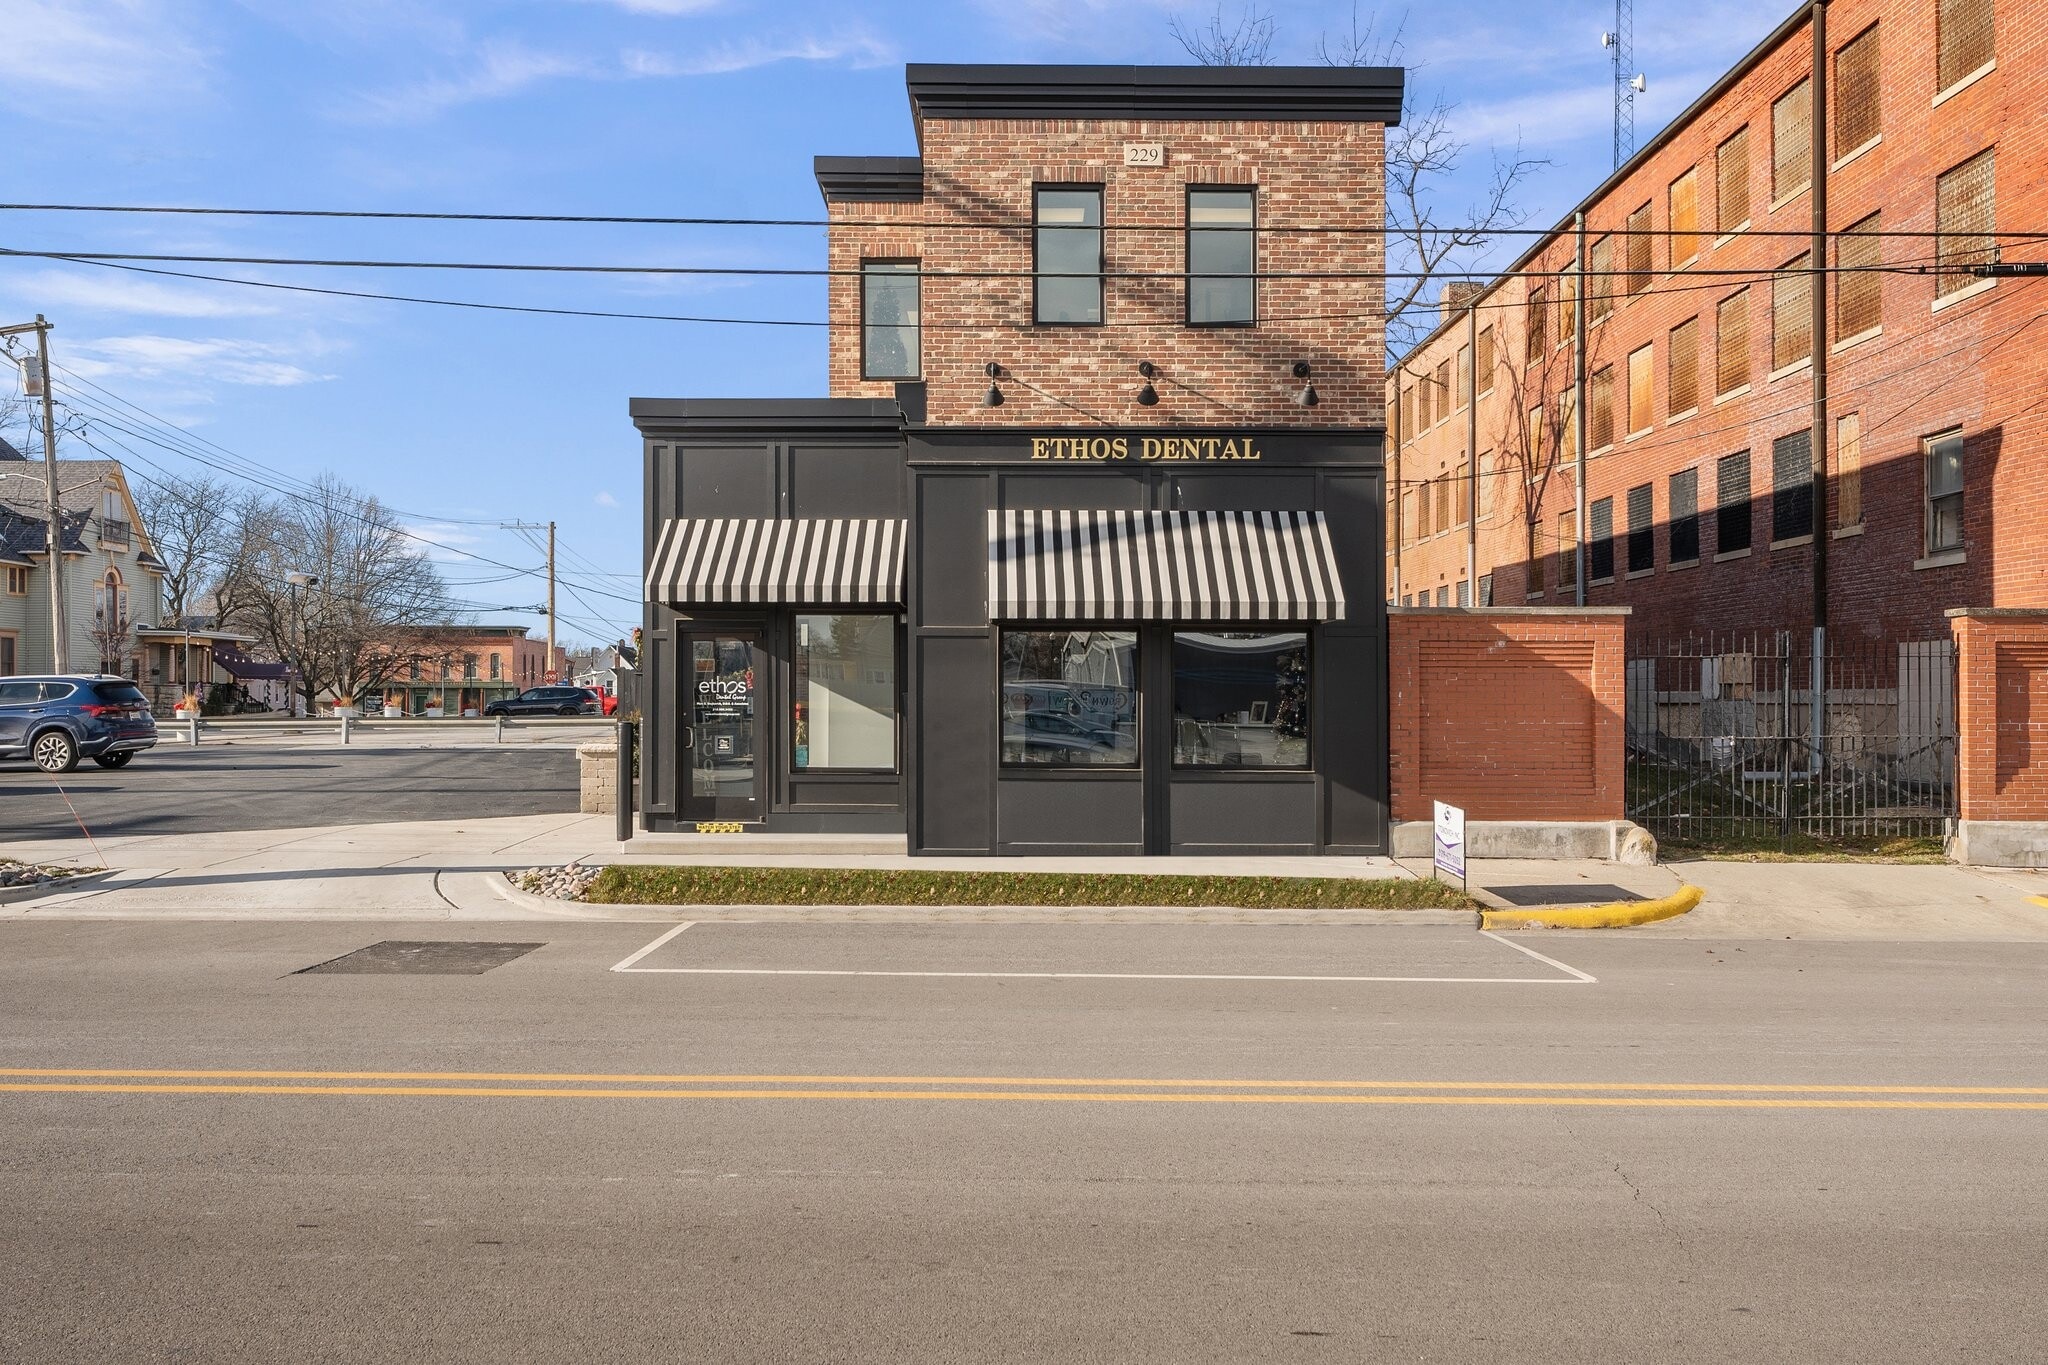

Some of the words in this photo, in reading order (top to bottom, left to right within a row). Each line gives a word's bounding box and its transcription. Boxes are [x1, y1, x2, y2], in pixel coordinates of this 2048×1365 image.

[1130, 148, 1159, 162] 229
[1031, 437, 1128, 460] ETHOS
[1140, 438, 1261, 460] DENTAL
[699, 675, 747, 694] ethos
[732, 693, 747, 701] Group
